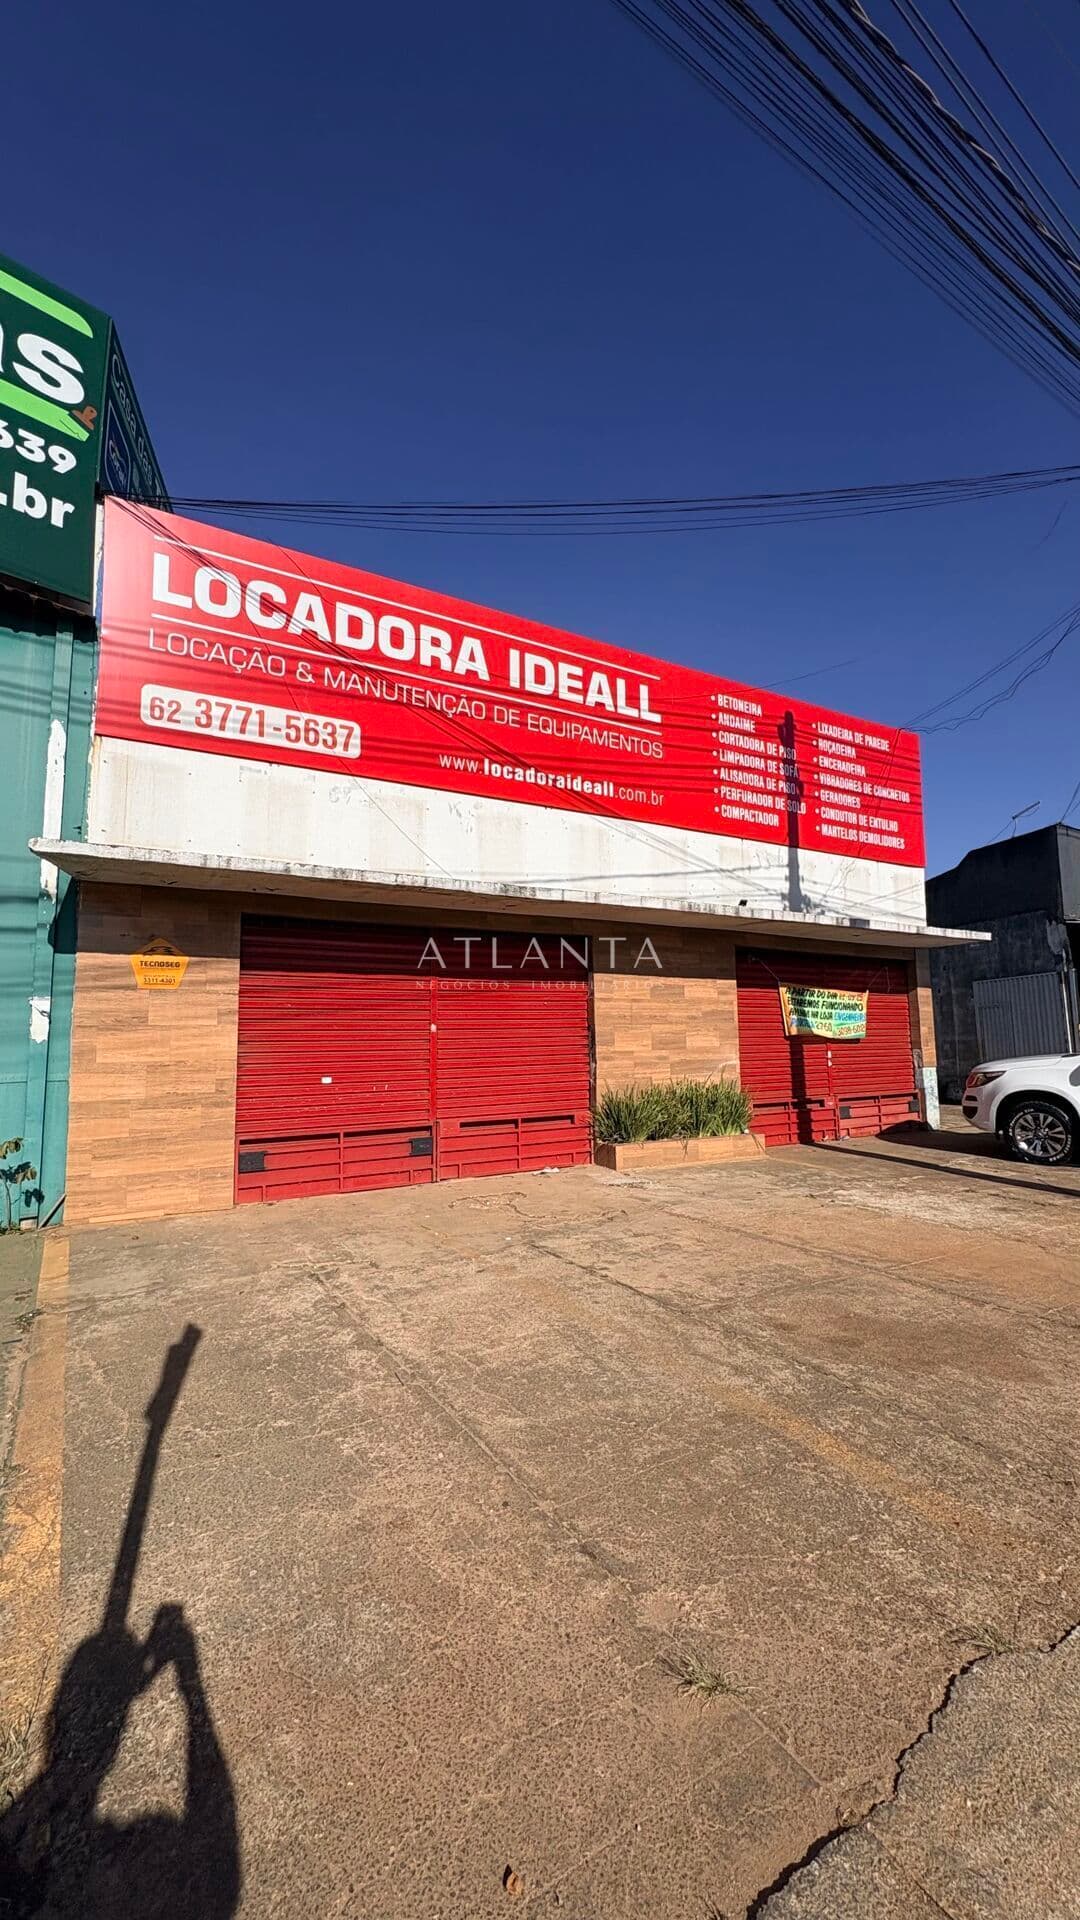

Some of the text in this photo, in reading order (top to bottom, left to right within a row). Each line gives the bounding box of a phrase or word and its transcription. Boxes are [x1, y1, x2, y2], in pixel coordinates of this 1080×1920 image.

[152, 552, 662, 724] LOCADORA IDEALL
[149, 627, 664, 759] LOCAÇÃO & MANUTENÇÃO DE EQUIPAMENTOS
[717, 694, 762, 717] BETONEIRA
[149, 696, 355, 753] 62 3771-5637
[718, 712, 756, 734] ANDAIME
[817, 721, 890, 752] LIXADEIRA DE PAREDE
[718, 731, 797, 761] CORTADORA DE PISO
[818, 738, 857, 760] ROÇADEIRA
[719, 749, 766, 773] LIMPADORA
[766, 760, 779, 774] DE
[818, 756, 867, 778] ENCERADEIRA
[439, 754, 664, 806] www.locadoraideall.com.br
[719, 767, 796, 796] ALISADORA DE PISO
[819, 772, 911, 803] VIBRADORES DE CONCRETOS
[720, 786, 807, 816] PERFURADOR DE SOLO
[819, 789, 861, 809] GERADORES
[720, 805, 780, 828] COMPACTADOR
[820, 807, 899, 833] CONDUTOR DE ENTULHO
[821, 824, 905, 850] MARTELOS DEMOLIDORES
